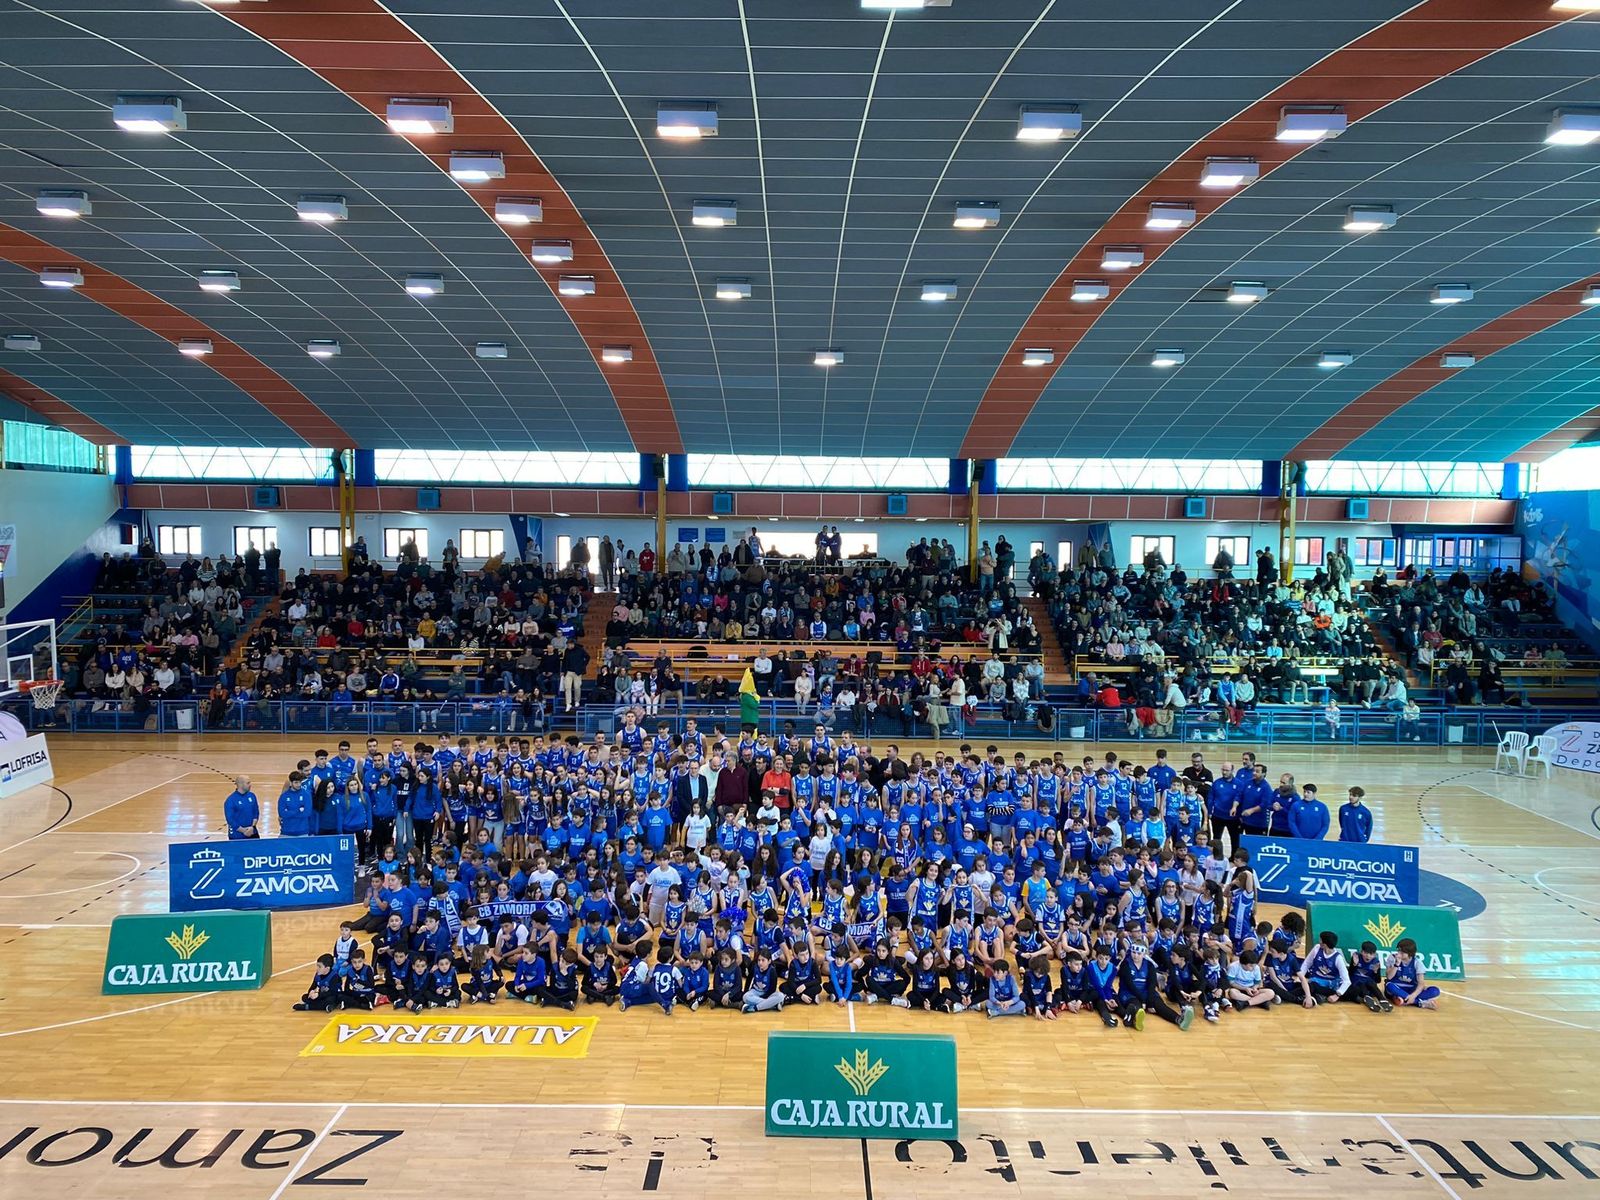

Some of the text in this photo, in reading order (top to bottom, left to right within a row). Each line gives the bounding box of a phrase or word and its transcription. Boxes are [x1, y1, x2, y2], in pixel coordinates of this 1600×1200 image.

[10, 750, 47, 773] LOFRISA
[236, 873, 340, 898] ZAMORA
[1300, 876, 1404, 903] ZAMORA
[478, 903, 537, 918] CB ZAMORA
[819, 918, 832, 931] CB
[107, 960, 257, 986] CAJA RURAL
[654, 971, 672, 994] 19
[337, 1023, 584, 1045] ALIMERKA
[770, 1098, 953, 1129] CAJA RURAL
